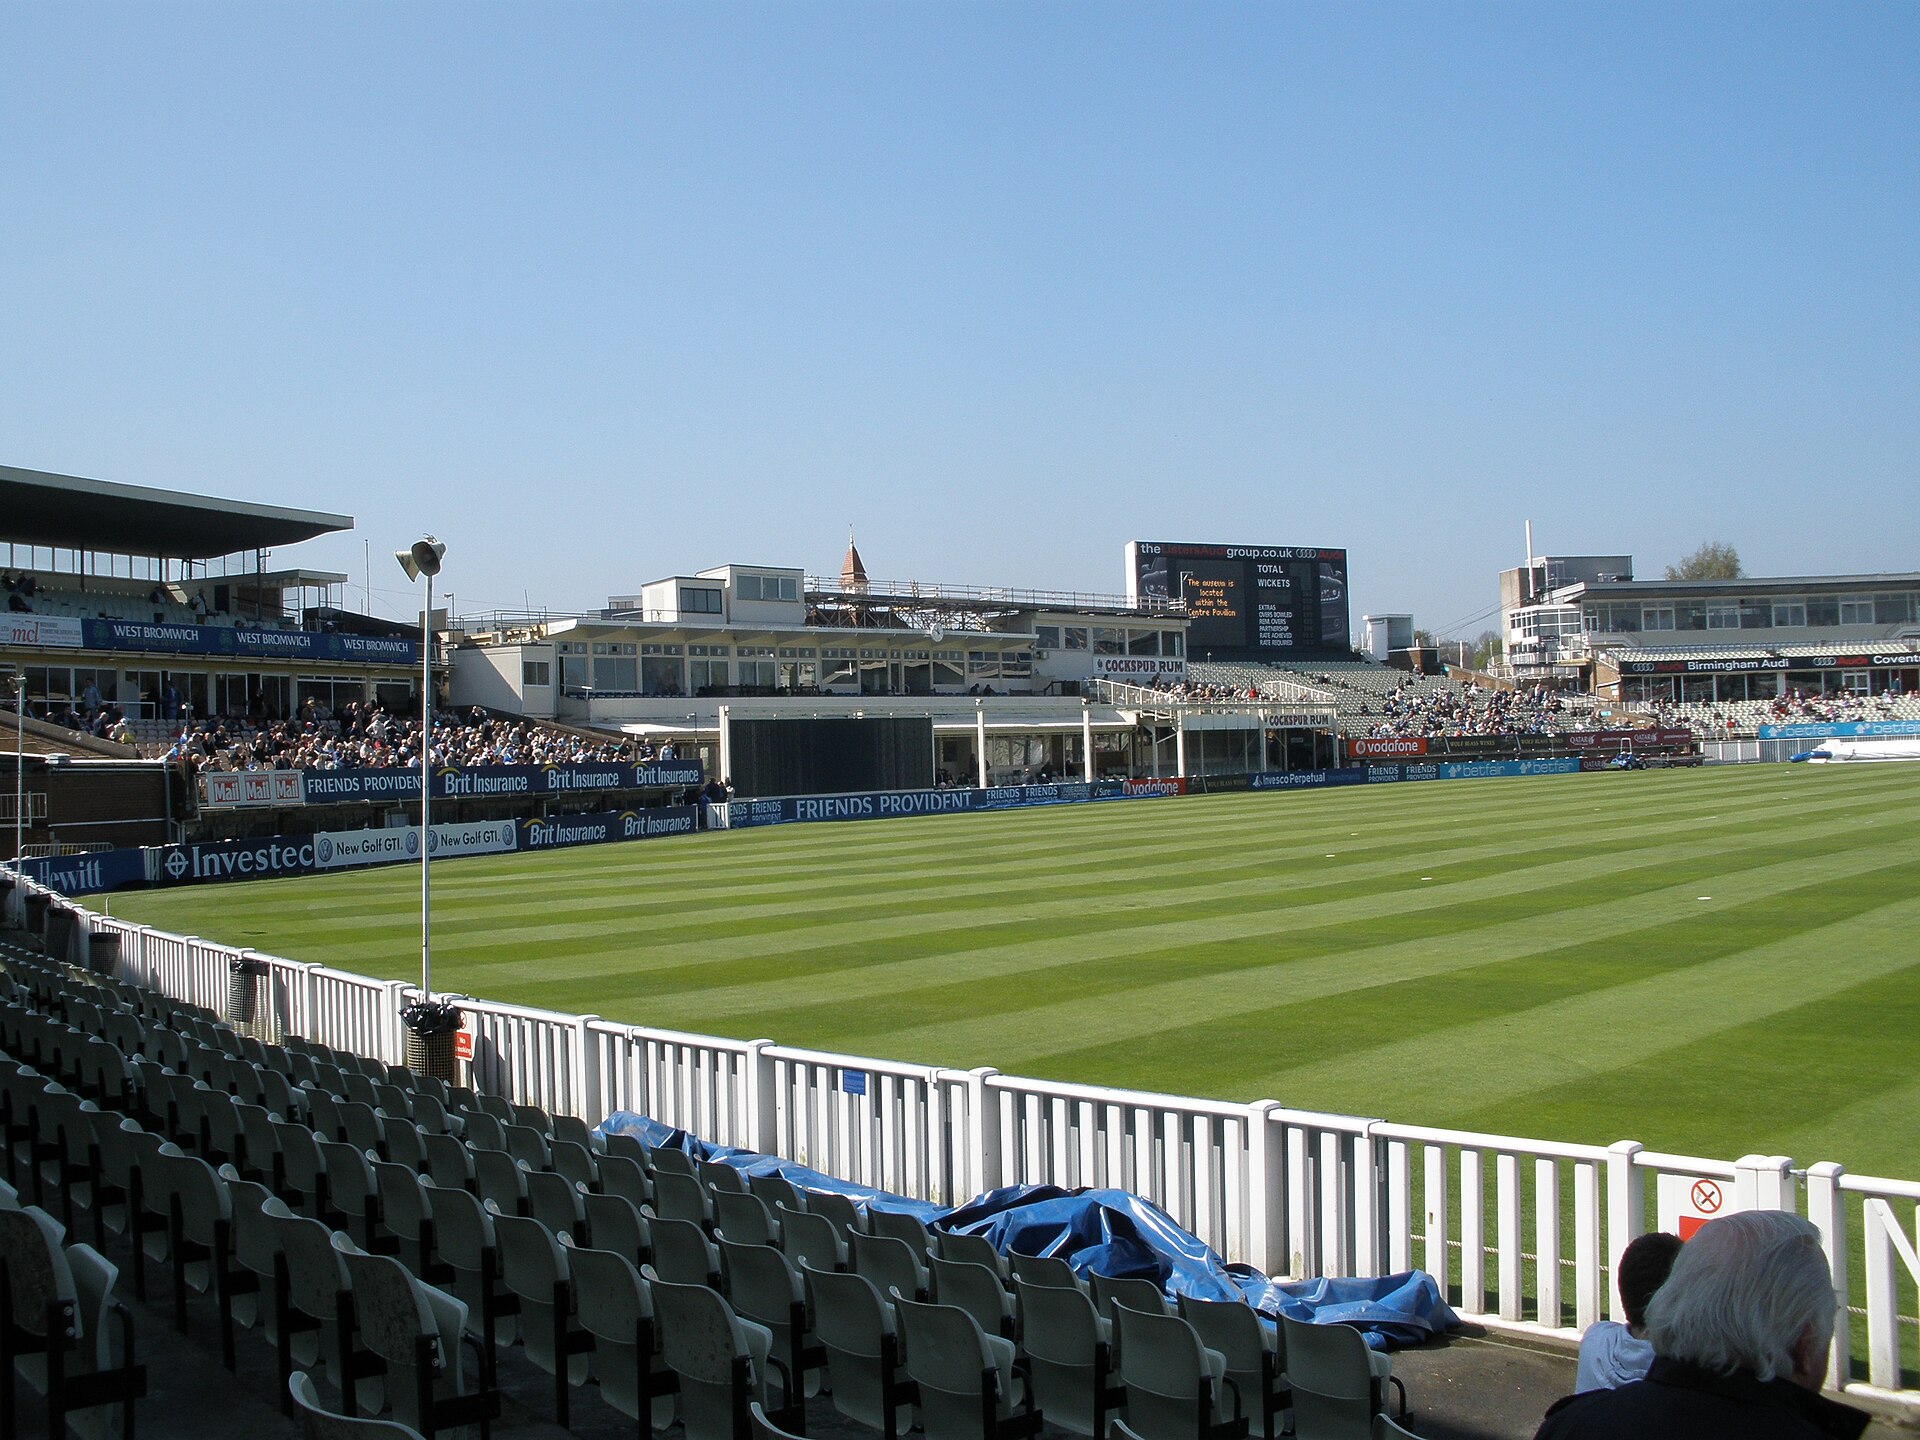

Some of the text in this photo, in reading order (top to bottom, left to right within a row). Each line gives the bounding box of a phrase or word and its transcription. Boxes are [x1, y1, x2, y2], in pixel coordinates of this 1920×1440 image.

[1140, 543, 1161, 554] the
[1226, 548, 1293, 559] group.co.uk
[1257, 564, 1284, 574] TOTAL
[1187, 578, 1200, 587] The
[1228, 579, 1234, 588] is
[1257, 578, 1291, 588] WICKETS
[1199, 589, 1224, 597] located
[1217, 598, 1228, 607] the
[1187, 608, 1236, 617] Centre Pavilion
[12, 620, 40, 643] mcl
[113, 624, 199, 641] WEST BROMWICH
[237, 632, 311, 647] WEST BROMWICH
[343, 638, 409, 653] WEST BROMWICH
[1105, 659, 1183, 673] COCKSPUR RUM
[1655, 658, 1789, 672] Audi Birmingham Audi
[1836, 656, 1869, 665] Audi
[1269, 714, 1329, 727] COCKSPUR RUM
[1633, 733, 1652, 742] QATAR
[1785, 725, 1837, 738] betfair
[1367, 739, 1419, 753] vodafone
[1569, 736, 1588, 745] QATAR
[1368, 765, 1399, 776] FRIENDS
[1406, 764, 1437, 775] FRIENDS
[1462, 762, 1505, 777] betfair
[1532, 759, 1573, 773] betfair
[547, 768, 619, 790] Brit Insurance
[636, 764, 699, 785] Brit Insurance
[1262, 774, 1289, 786] Invesco
[1289, 771, 1326, 785] Perpetual
[1368, 774, 1399, 783] PROVIDENT
[1406, 773, 1436, 781] PROVIDENT
[276, 779, 299, 798] Mail
[307, 777, 360, 794] FRIENDS
[444, 771, 529, 794] Brit Insurance
[1132, 780, 1179, 795] vodafone
[214, 782, 240, 802] Mail
[246, 780, 271, 800] Mail
[986, 788, 1020, 800] FRIENDS
[1025, 786, 1058, 797] FRIENDS
[1099, 788, 1111, 797] Sure
[730, 803, 748, 816] ENDS
[751, 801, 782, 814] FRIENDS
[796, 791, 972, 819] FRIENDS PROVIDENT
[624, 813, 691, 836] Brit Insurance
[440, 829, 500, 846] New Golf GTI.
[529, 822, 606, 845] Brit Insurance
[336, 837, 403, 856] New Golf GTI.
[193, 842, 314, 878] Investec
[39, 859, 105, 892] Hewitt
